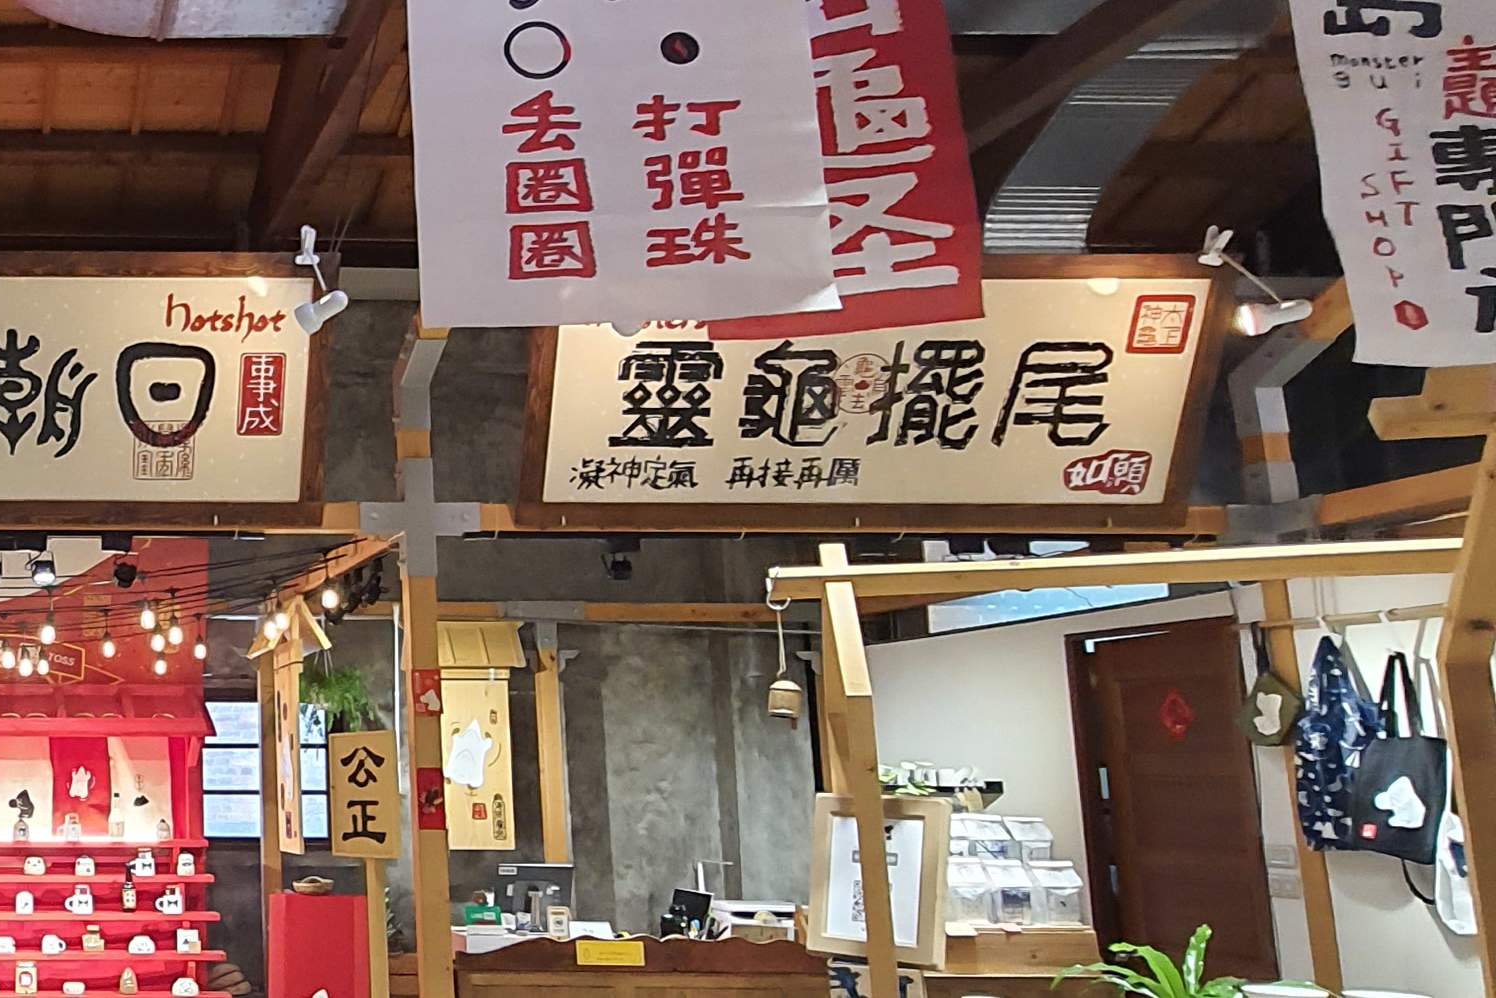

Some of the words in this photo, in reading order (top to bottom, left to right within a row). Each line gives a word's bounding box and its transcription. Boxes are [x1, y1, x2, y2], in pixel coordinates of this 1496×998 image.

[632, 95, 752, 268] 打彈珠
[340, 746, 388, 845] 公正
